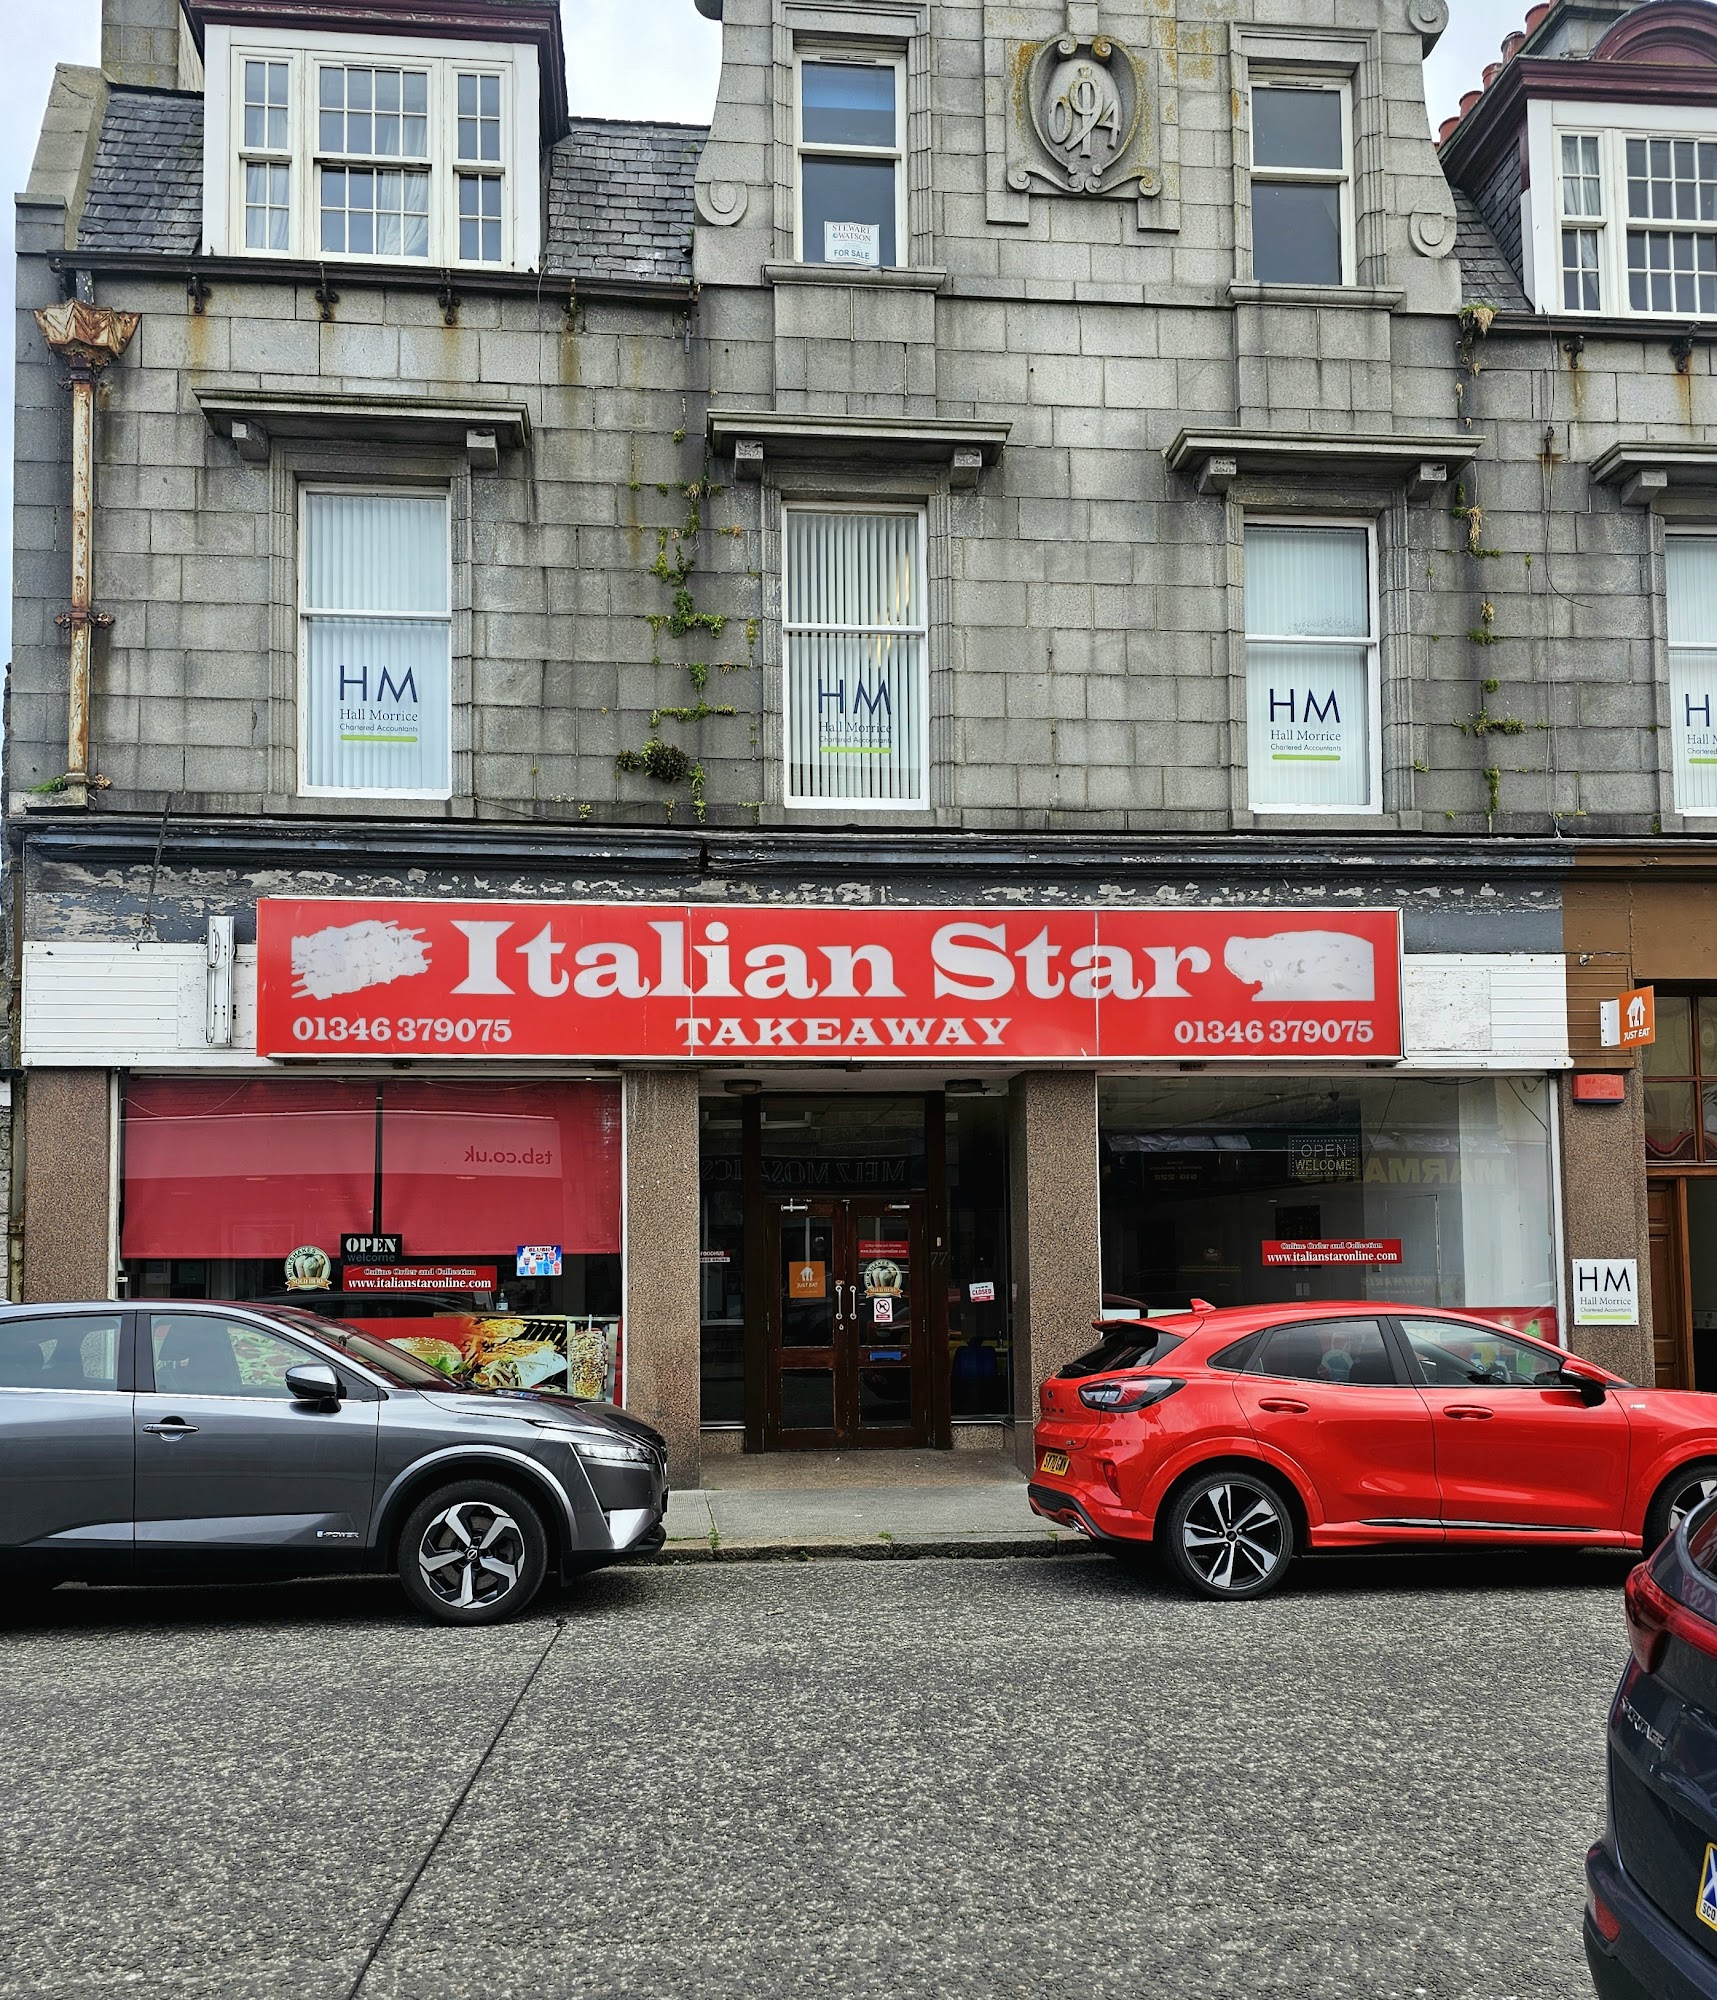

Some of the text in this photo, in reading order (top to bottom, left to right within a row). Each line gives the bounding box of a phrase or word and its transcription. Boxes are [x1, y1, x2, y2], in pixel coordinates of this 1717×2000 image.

[832, 224, 871, 235] STEWART
[834, 249, 870, 259] FOR SALE
[340, 665, 418, 703] HM
[818, 679, 892, 715] HM
[1270, 688, 1341, 723] HM
[340, 708, 418, 721] Hall Morrice
[340, 723, 418, 732] Chartered Accountants
[819, 721, 892, 733] Hall Morrice
[1270, 730, 1341, 741] Hall Morrice
[1687, 734, 1709, 745] Hall
[1270, 743, 1342, 752] Chartered Accountants
[450, 919, 1211, 1001] Italian Star
[292, 1016, 512, 1043] 01346 379075
[675, 1017, 1013, 1047] TAKEAWAY
[1174, 1019, 1374, 1044] 01346 379075
[1623, 1027, 1651, 1042] JUST EAT
[1300, 1142, 1347, 1158] OPEN
[1294, 1159, 1353, 1172] WELCOME
[345, 1238, 397, 1253] OPEN
[1330, 1241, 1344, 1249] and
[347, 1253, 395, 1263] welcome
[1267, 1251, 1397, 1262] www.italianstaronline.com
[288, 1248, 316, 1278] MILKSHAKES
[364, 1267, 391, 1276] Online
[393, 1267, 417, 1276] Order
[418, 1268, 435, 1276] and
[348, 1276, 491, 1288] www.italianstaronline.com
[1579, 1265, 1632, 1293] HM
[971, 1288, 992, 1296] CLOSED
[1580, 1296, 1632, 1305] Hall Morrice
